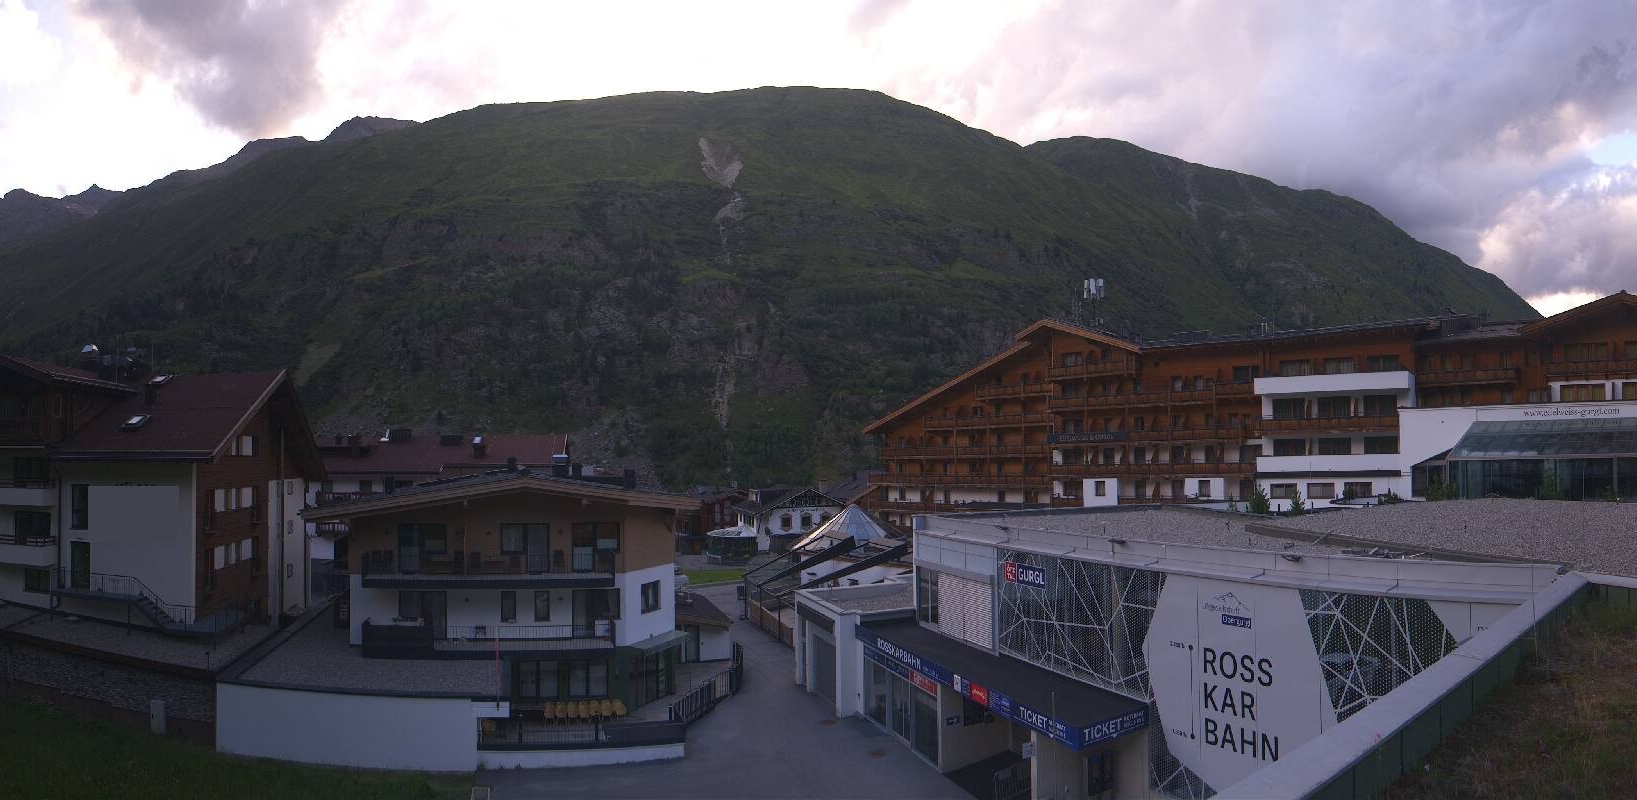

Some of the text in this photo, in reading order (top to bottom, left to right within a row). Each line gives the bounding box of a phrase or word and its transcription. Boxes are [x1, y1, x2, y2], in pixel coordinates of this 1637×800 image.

[1018, 568, 1045, 584] GURGL
[877, 637, 921, 669] ROSSKARBAHN
[1203, 647, 1273, 687] ROSS
[1203, 682, 1256, 721] KAR
[1019, 706, 1048, 730] TICKET
[1084, 718, 1122, 741] TICKET
[1204, 717, 1279, 762] BAHN
